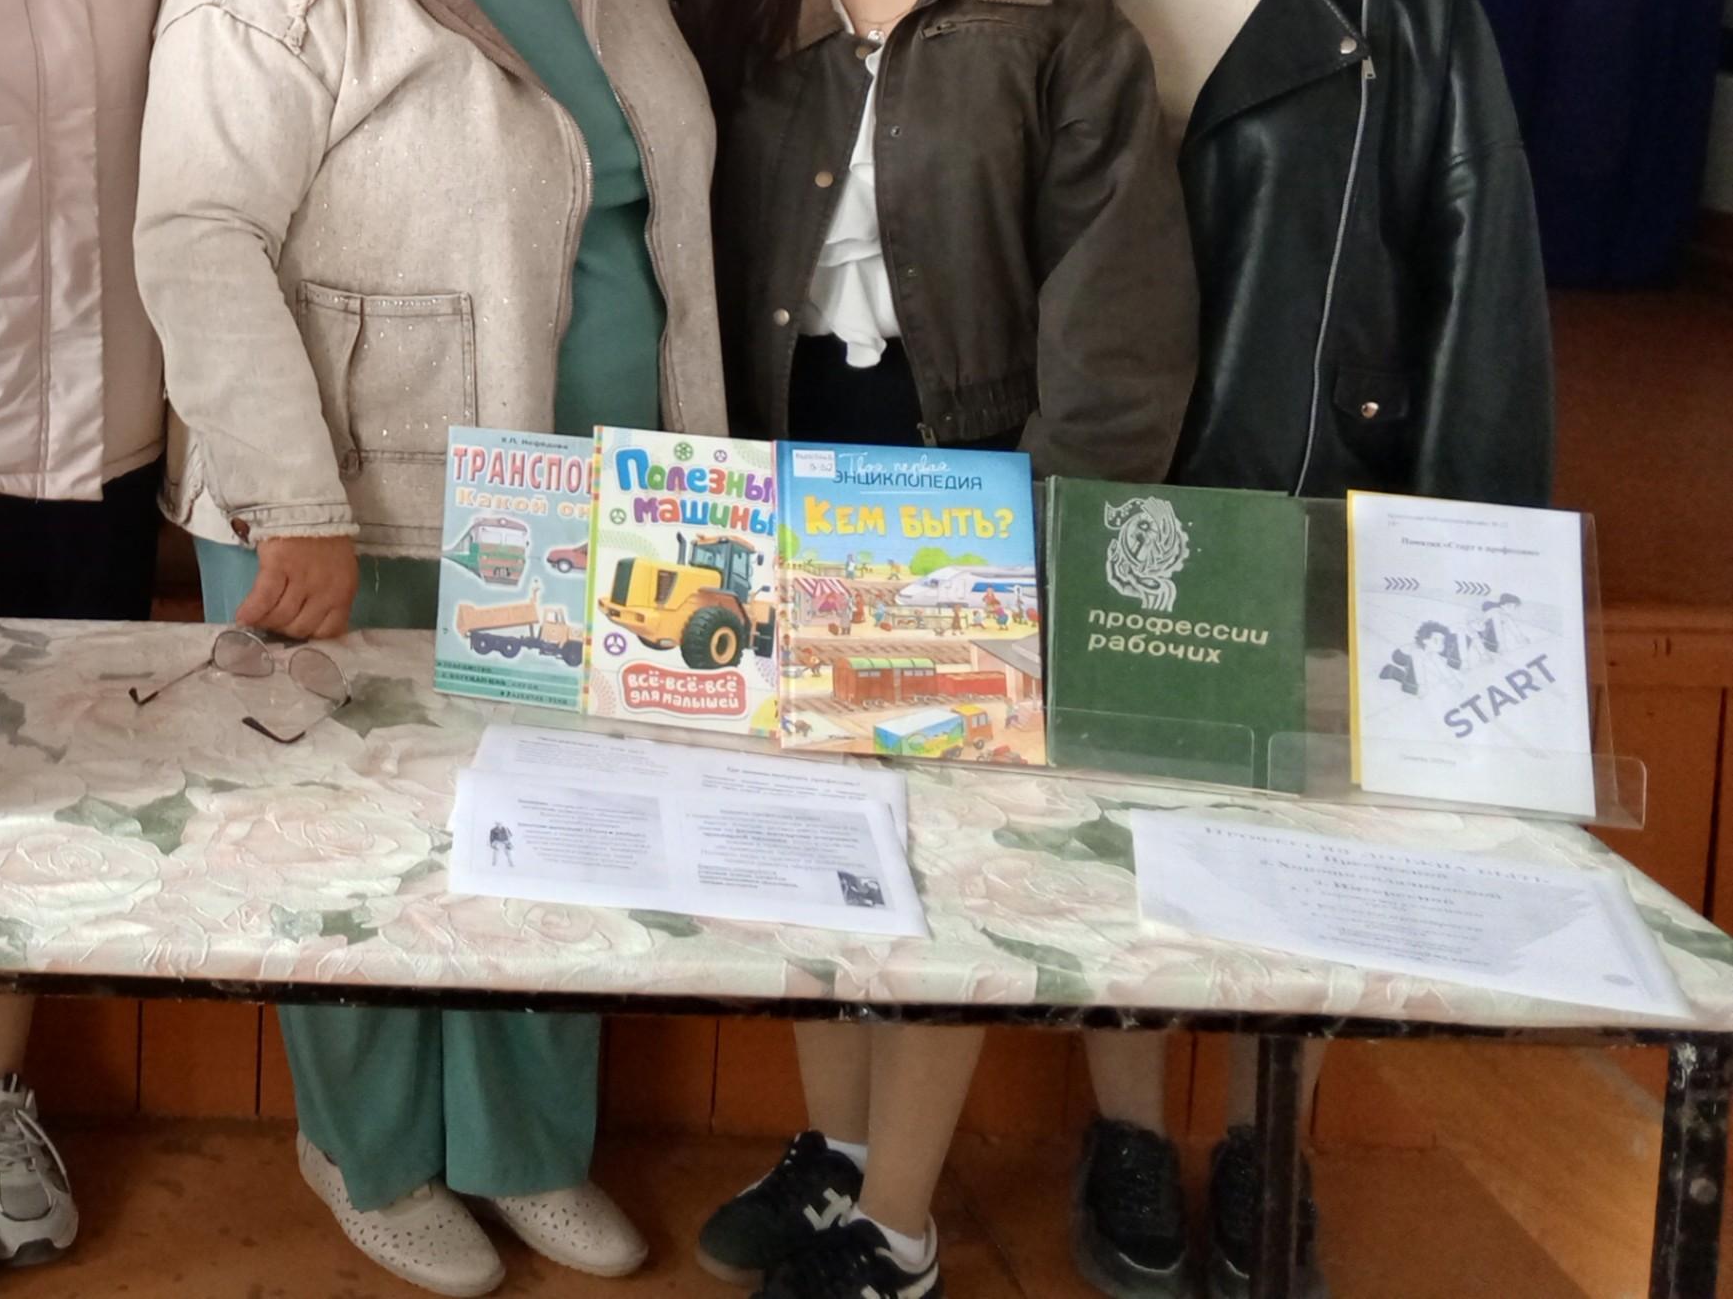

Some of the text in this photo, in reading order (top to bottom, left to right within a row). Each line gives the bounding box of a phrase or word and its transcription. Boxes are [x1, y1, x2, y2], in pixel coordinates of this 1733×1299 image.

[833, 470, 983, 490] ЭНЦИКЛОПЕДИЯ
[1088, 609, 1269, 645] профессии
[1088, 632, 1222, 664] рабочих
[1443, 653, 1557, 739] START
